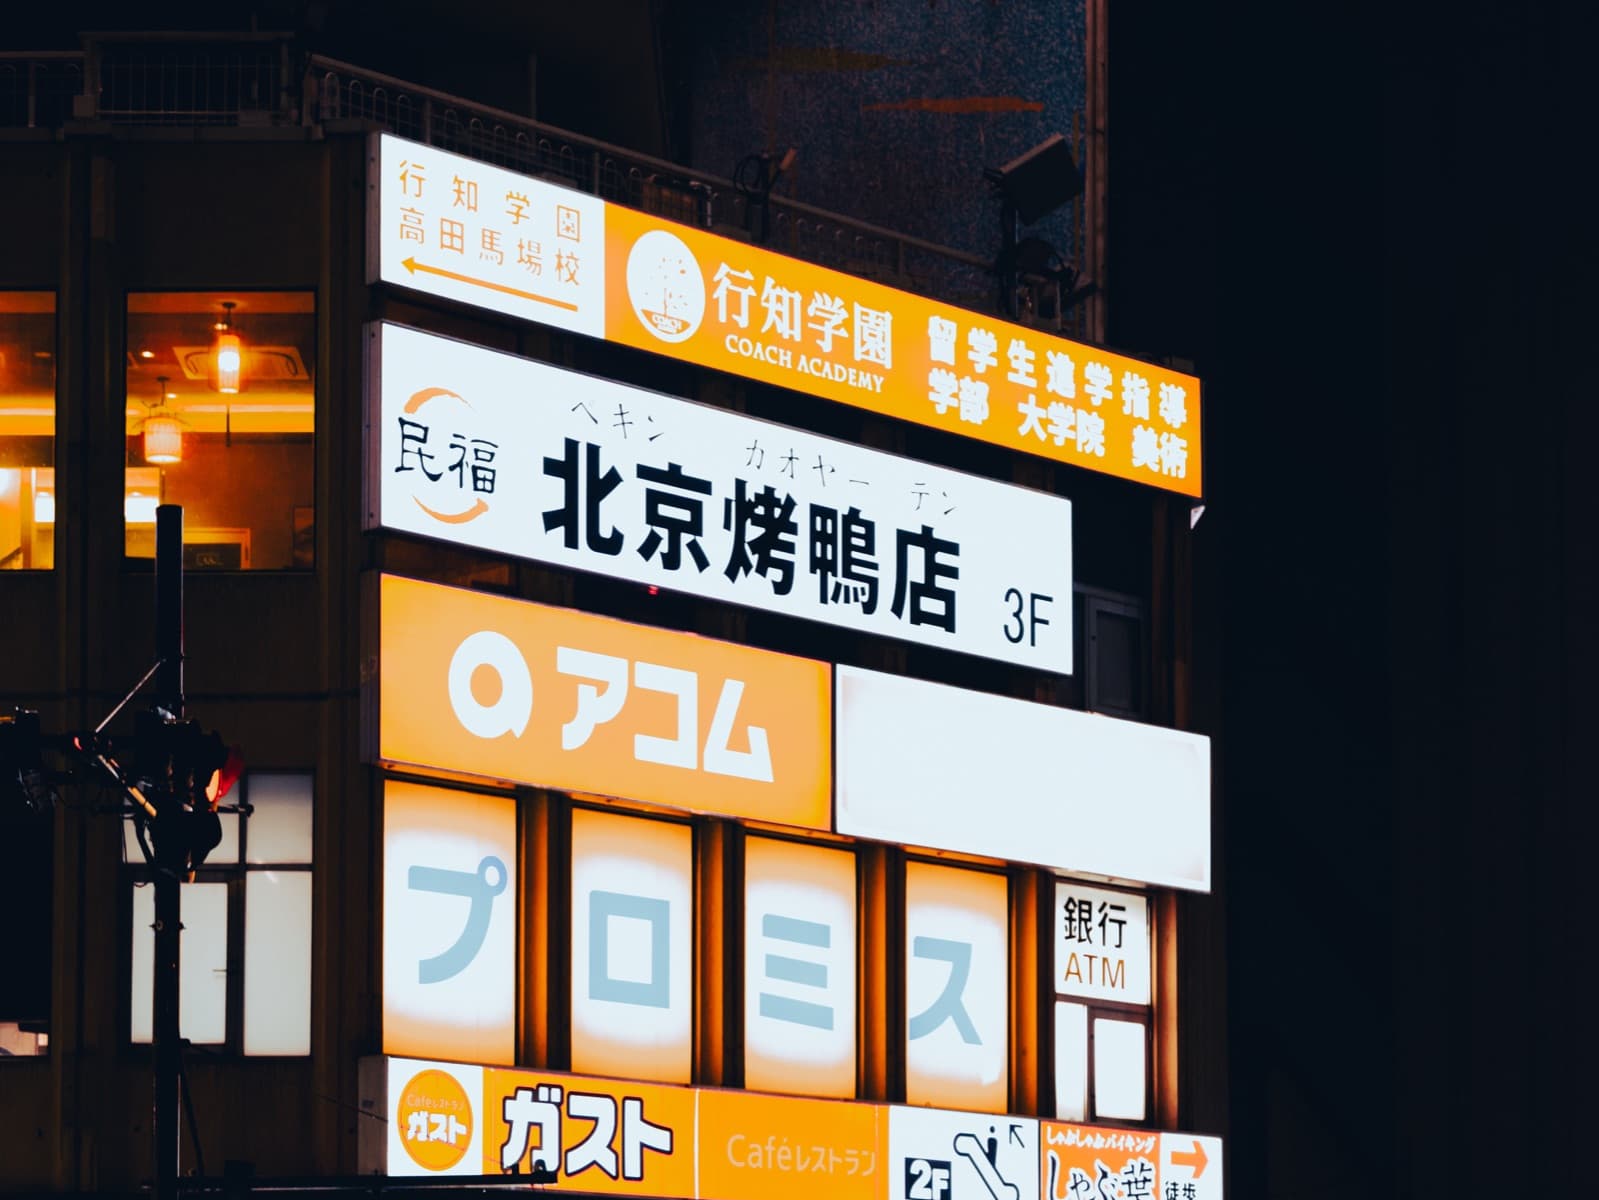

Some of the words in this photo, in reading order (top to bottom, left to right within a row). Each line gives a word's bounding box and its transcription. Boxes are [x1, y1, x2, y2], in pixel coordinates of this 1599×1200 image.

[399, 159, 581, 242] 行知学園
[399, 207, 581, 286] 高田馬場校
[713, 262, 893, 369] 行知学園
[725, 334, 793, 369] COACH
[797, 354, 884, 393] ACADEMY
[395, 417, 498, 494] 民福
[542, 437, 961, 633] 北京烤鴨店
[1003, 588, 1053, 647] 3F
[556, 646, 774, 783] アコム
[1064, 896, 1127, 948] 銀行
[1065, 952, 1125, 989] ATM
[407, 1111, 467, 1146] ガスト
[500, 1083, 673, 1181] ガスト
[909, 1160, 950, 1200] 2F
